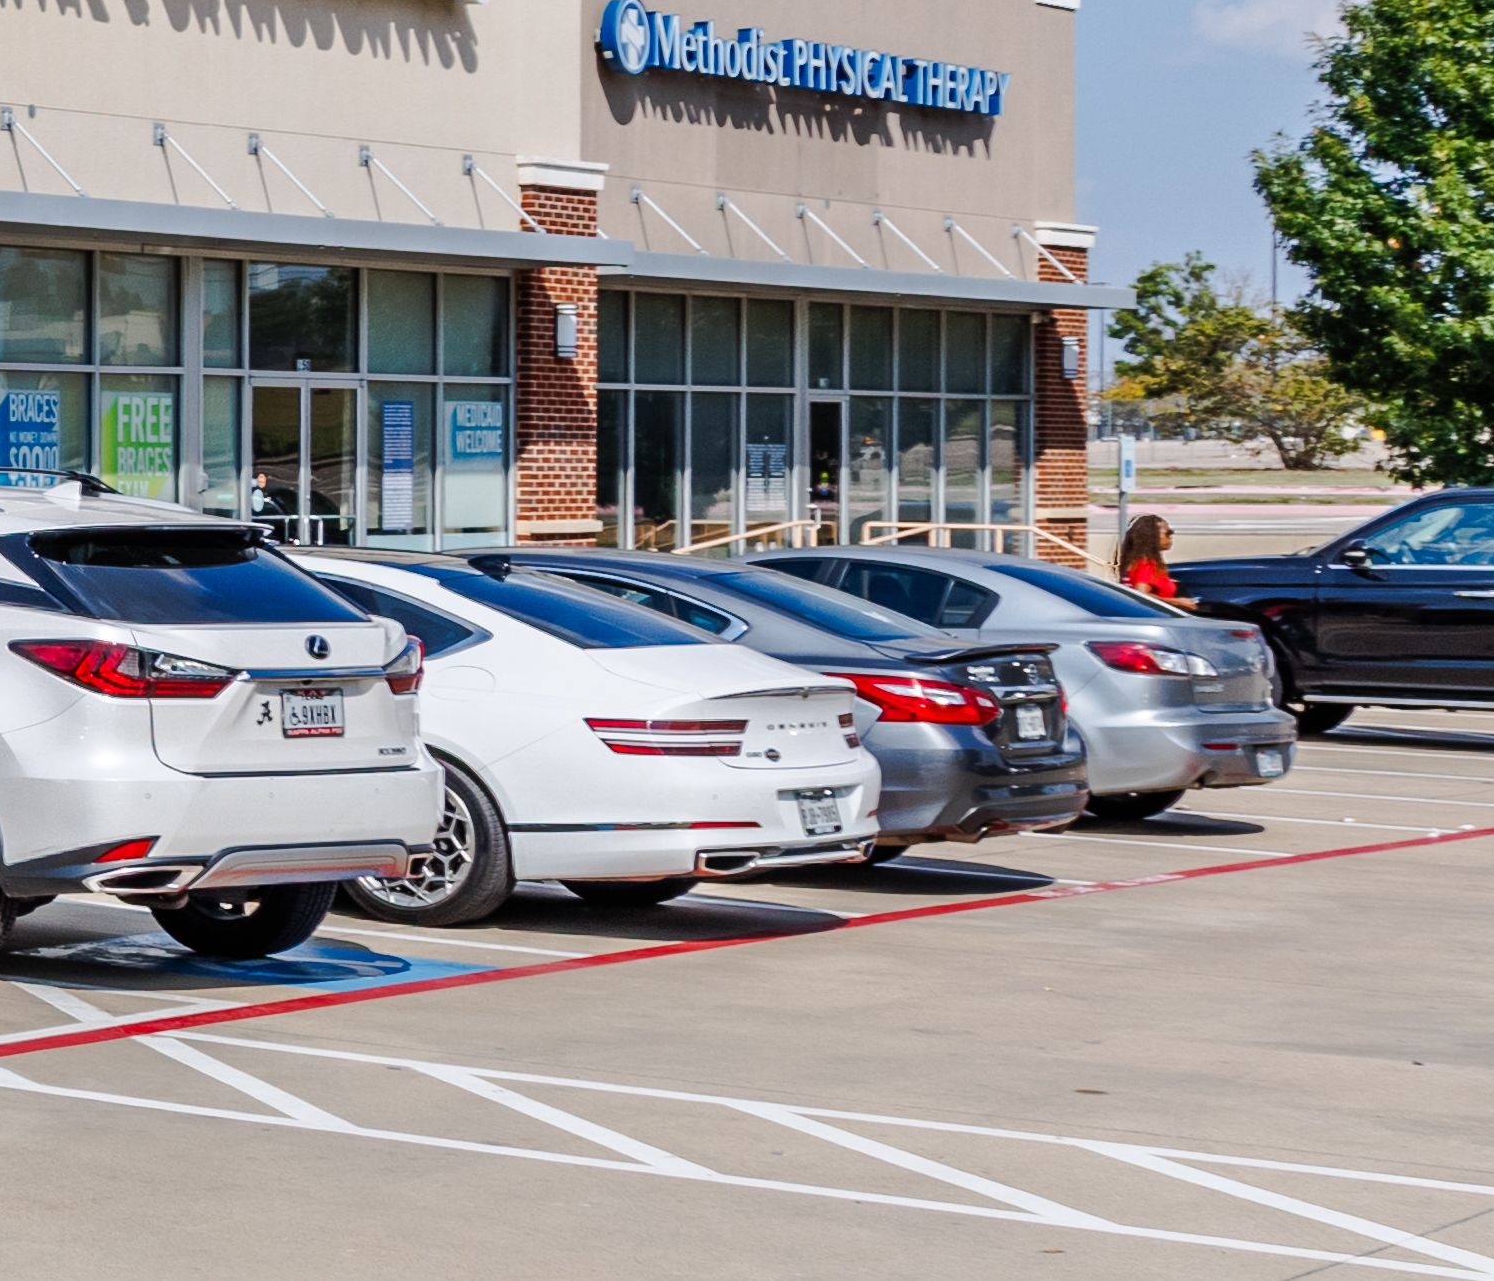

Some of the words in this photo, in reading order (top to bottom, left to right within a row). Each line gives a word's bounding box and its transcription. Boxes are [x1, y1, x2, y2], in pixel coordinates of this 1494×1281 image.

[651, 11, 790, 86] Methodist
[791, 39, 908, 103] PHYSICAL
[913, 59, 1011, 118] THERAPY
[9, 394, 59, 423] BRACES
[118, 396, 172, 443] FREE
[456, 405, 502, 427] MEDICAID
[455, 430, 502, 453] WELCOME
[119, 447, 170, 476] BRACES
